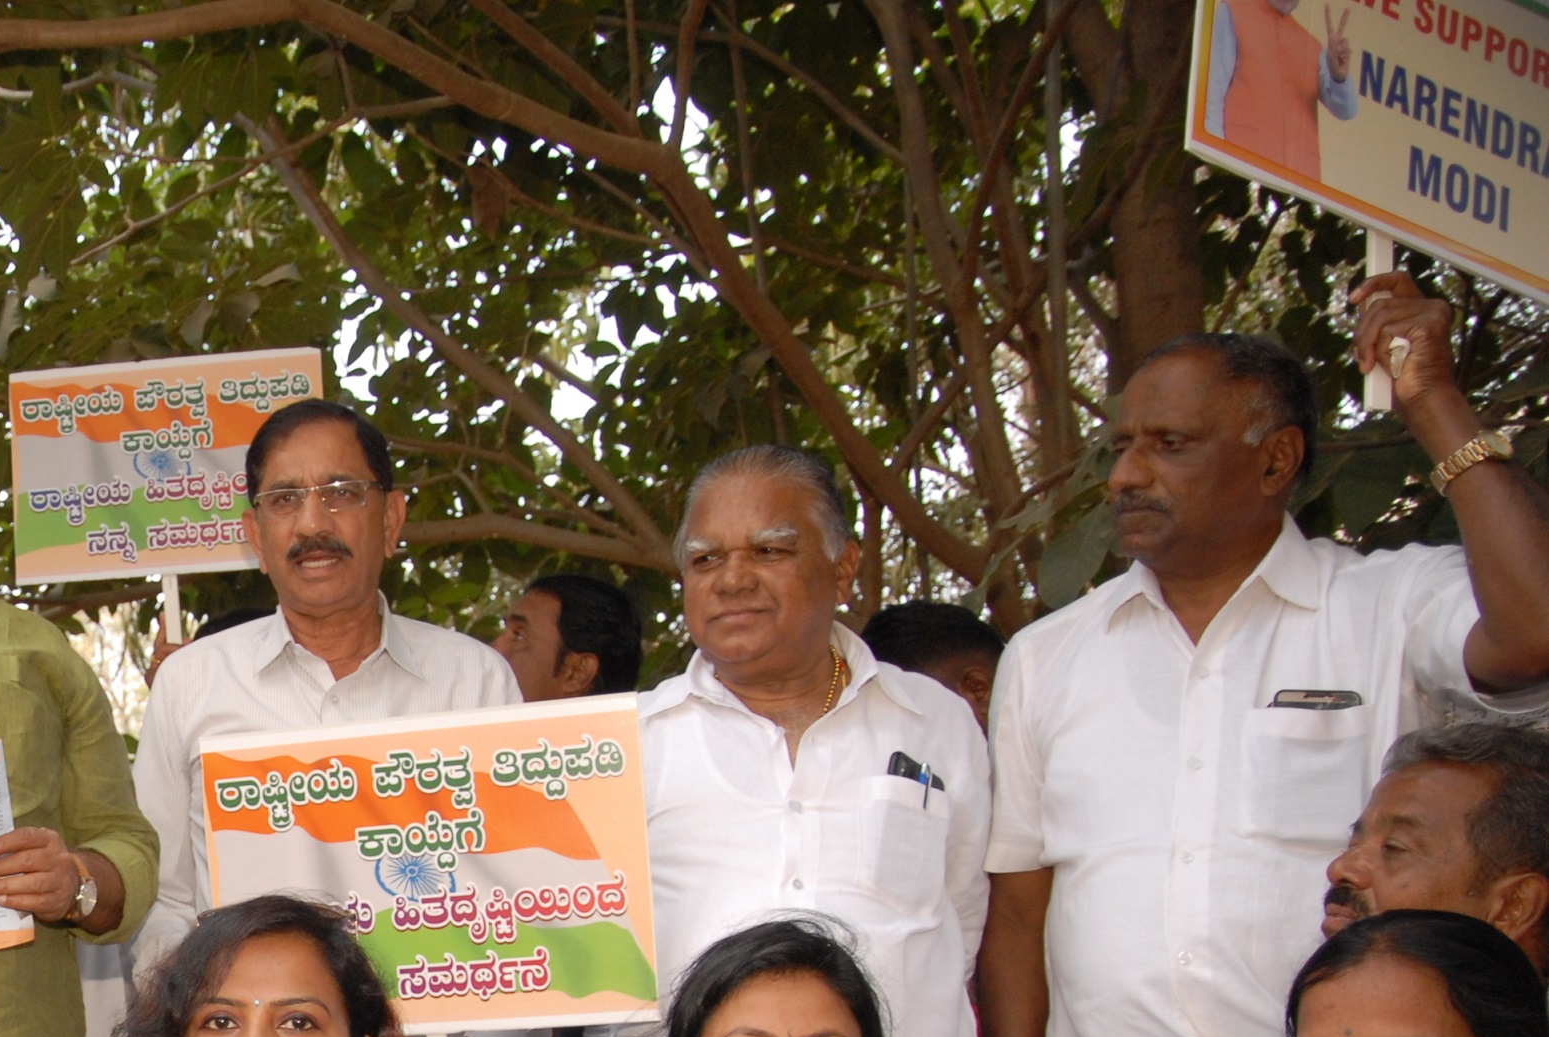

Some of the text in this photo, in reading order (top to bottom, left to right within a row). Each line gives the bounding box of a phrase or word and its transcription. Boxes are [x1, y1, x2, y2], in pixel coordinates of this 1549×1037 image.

[1414, 0, 1549, 89] SUPPOR
[1408, 145, 1510, 233] MODI
[20, 370, 311, 434] ರಾಷ್ಟ್ರೀಯ ಪೌರತ್ವ ತಿದ್ದುಪಡಿ
[122, 419, 213, 460] ಕಾಯ್ದೆಗೆ
[29, 476, 132, 526] ರಾಷ್ಟ್ರೀಯ
[87, 521, 138, 562] ನನ್ನ
[215, 736, 626, 831] ರಾಷ್ಟ್ರೀಯ ಪೌರತ್ವ ತಿದ್ದುಪಡಿ
[356, 808, 486, 871] ಕಾಯ್ದೆಗೆ
[393, 870, 628, 943] ಹಿತದೃಷ್ಟಿಯಿಂದ
[397, 947, 551, 1000] ಸಮರ್ಥನೆ
